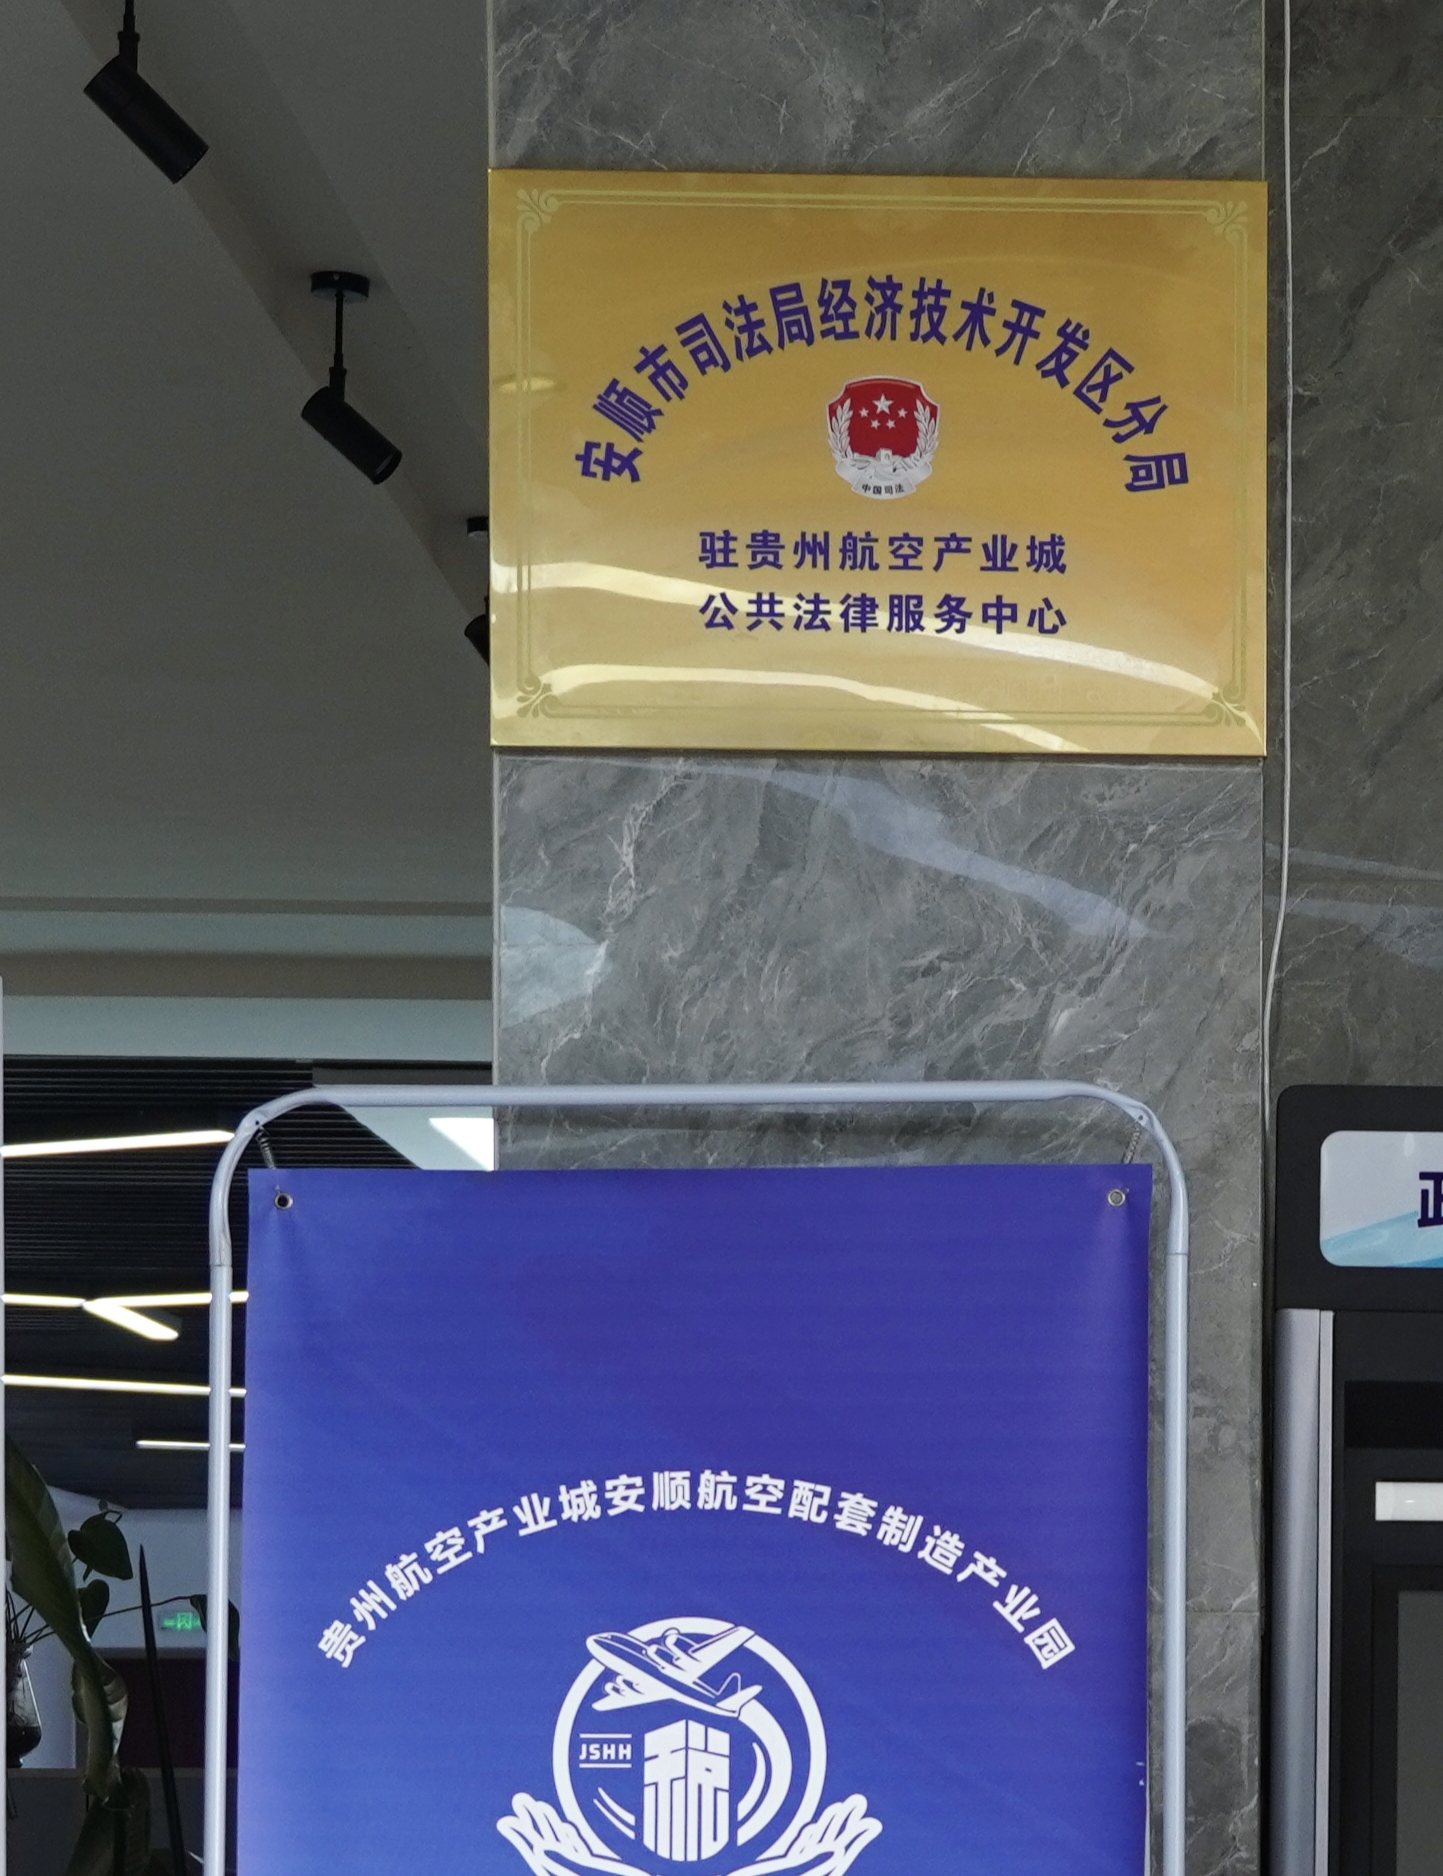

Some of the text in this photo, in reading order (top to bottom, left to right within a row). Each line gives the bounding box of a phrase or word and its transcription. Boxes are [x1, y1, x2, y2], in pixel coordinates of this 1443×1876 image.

[575, 274, 1189, 493] 安顺市司法局经济技术开发区分局
[862, 483, 904, 495] 中国司法
[697, 530, 1068, 575] 驻贵州航空产业城
[698, 591, 1068, 636] 公共法律服务中心
[316, 1469, 1076, 1670] 贵州航空产业城安顺航空配套制造产业园
[579, 1743, 632, 1762] JSHH
